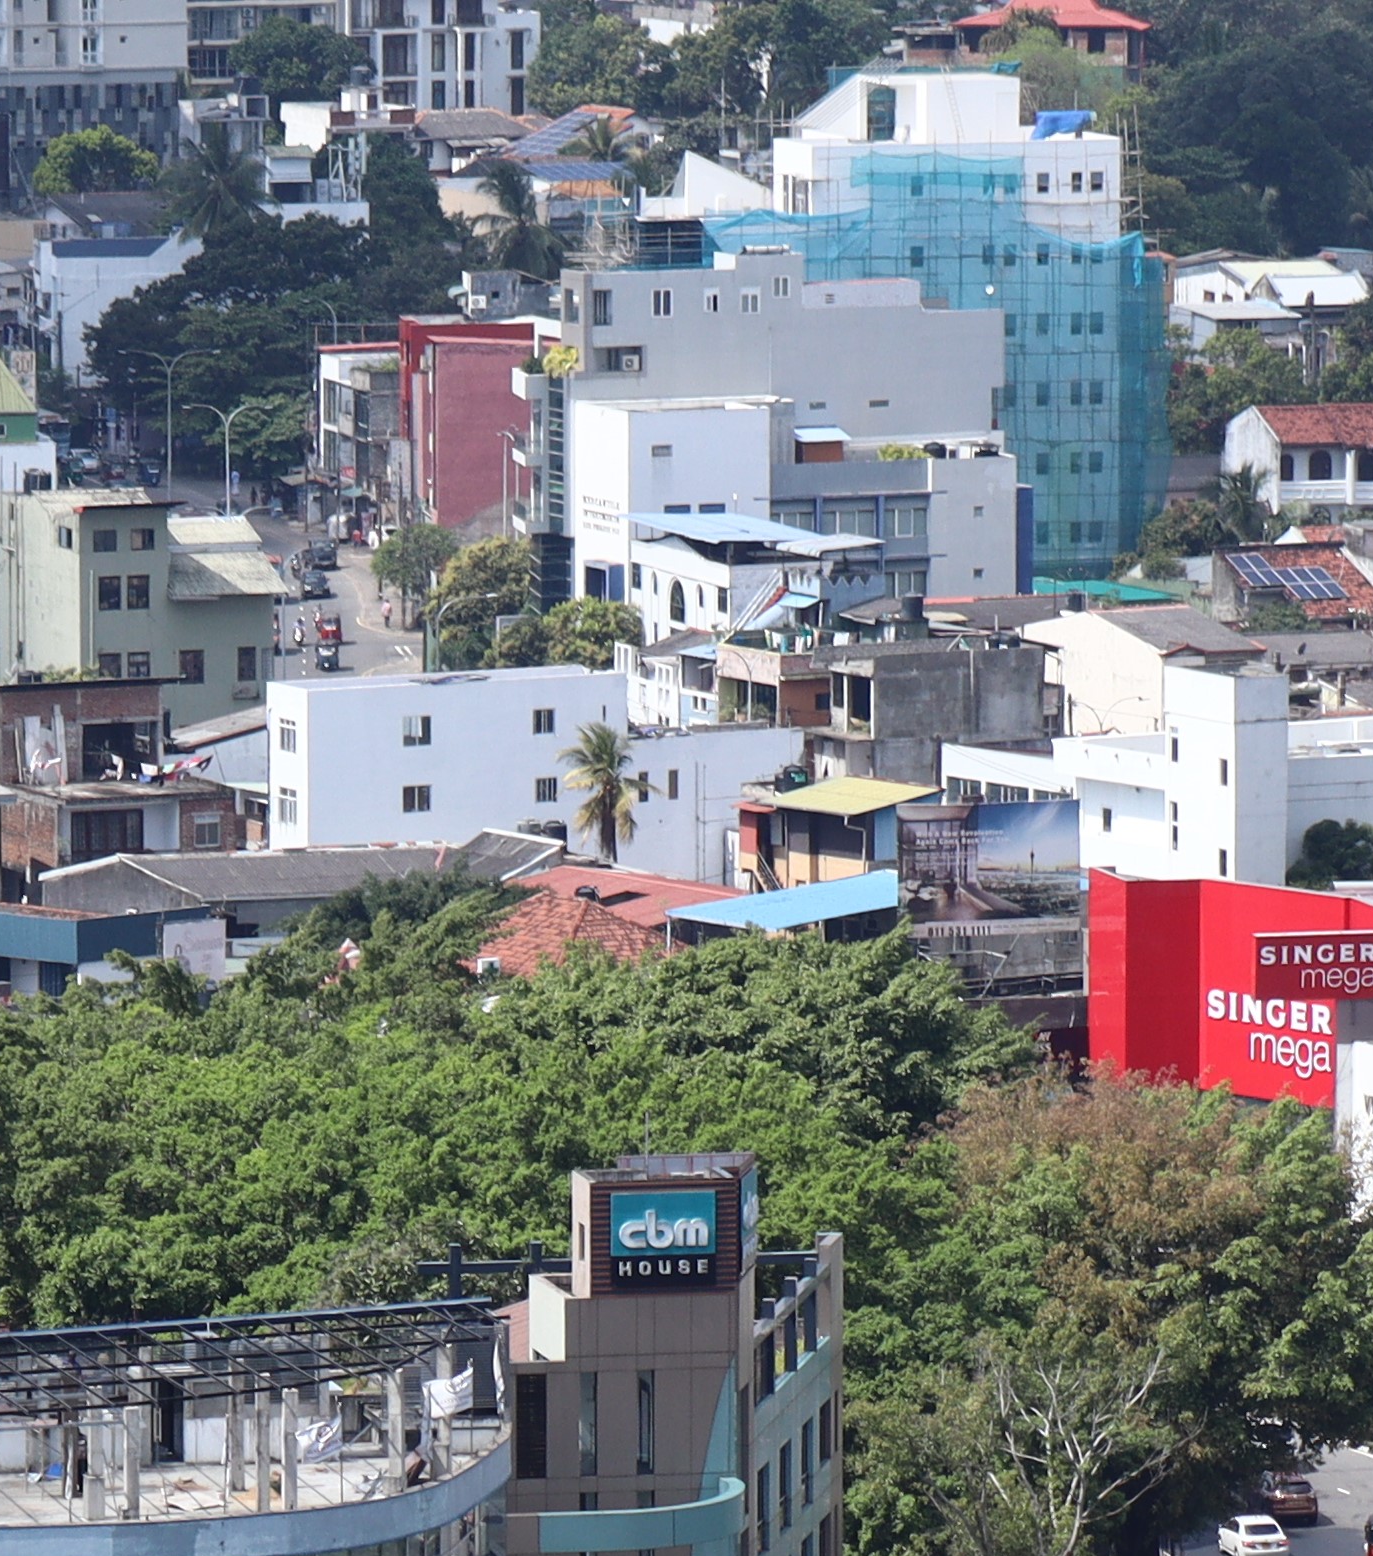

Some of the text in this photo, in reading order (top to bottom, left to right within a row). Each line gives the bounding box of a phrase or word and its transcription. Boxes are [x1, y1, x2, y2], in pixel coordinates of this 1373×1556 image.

[1207, 989, 1332, 1035] SINGER
[1249, 1031, 1332, 1079] mega
[619, 1208, 709, 1249] cbm
[618, 1259, 709, 1277] HOUSE
